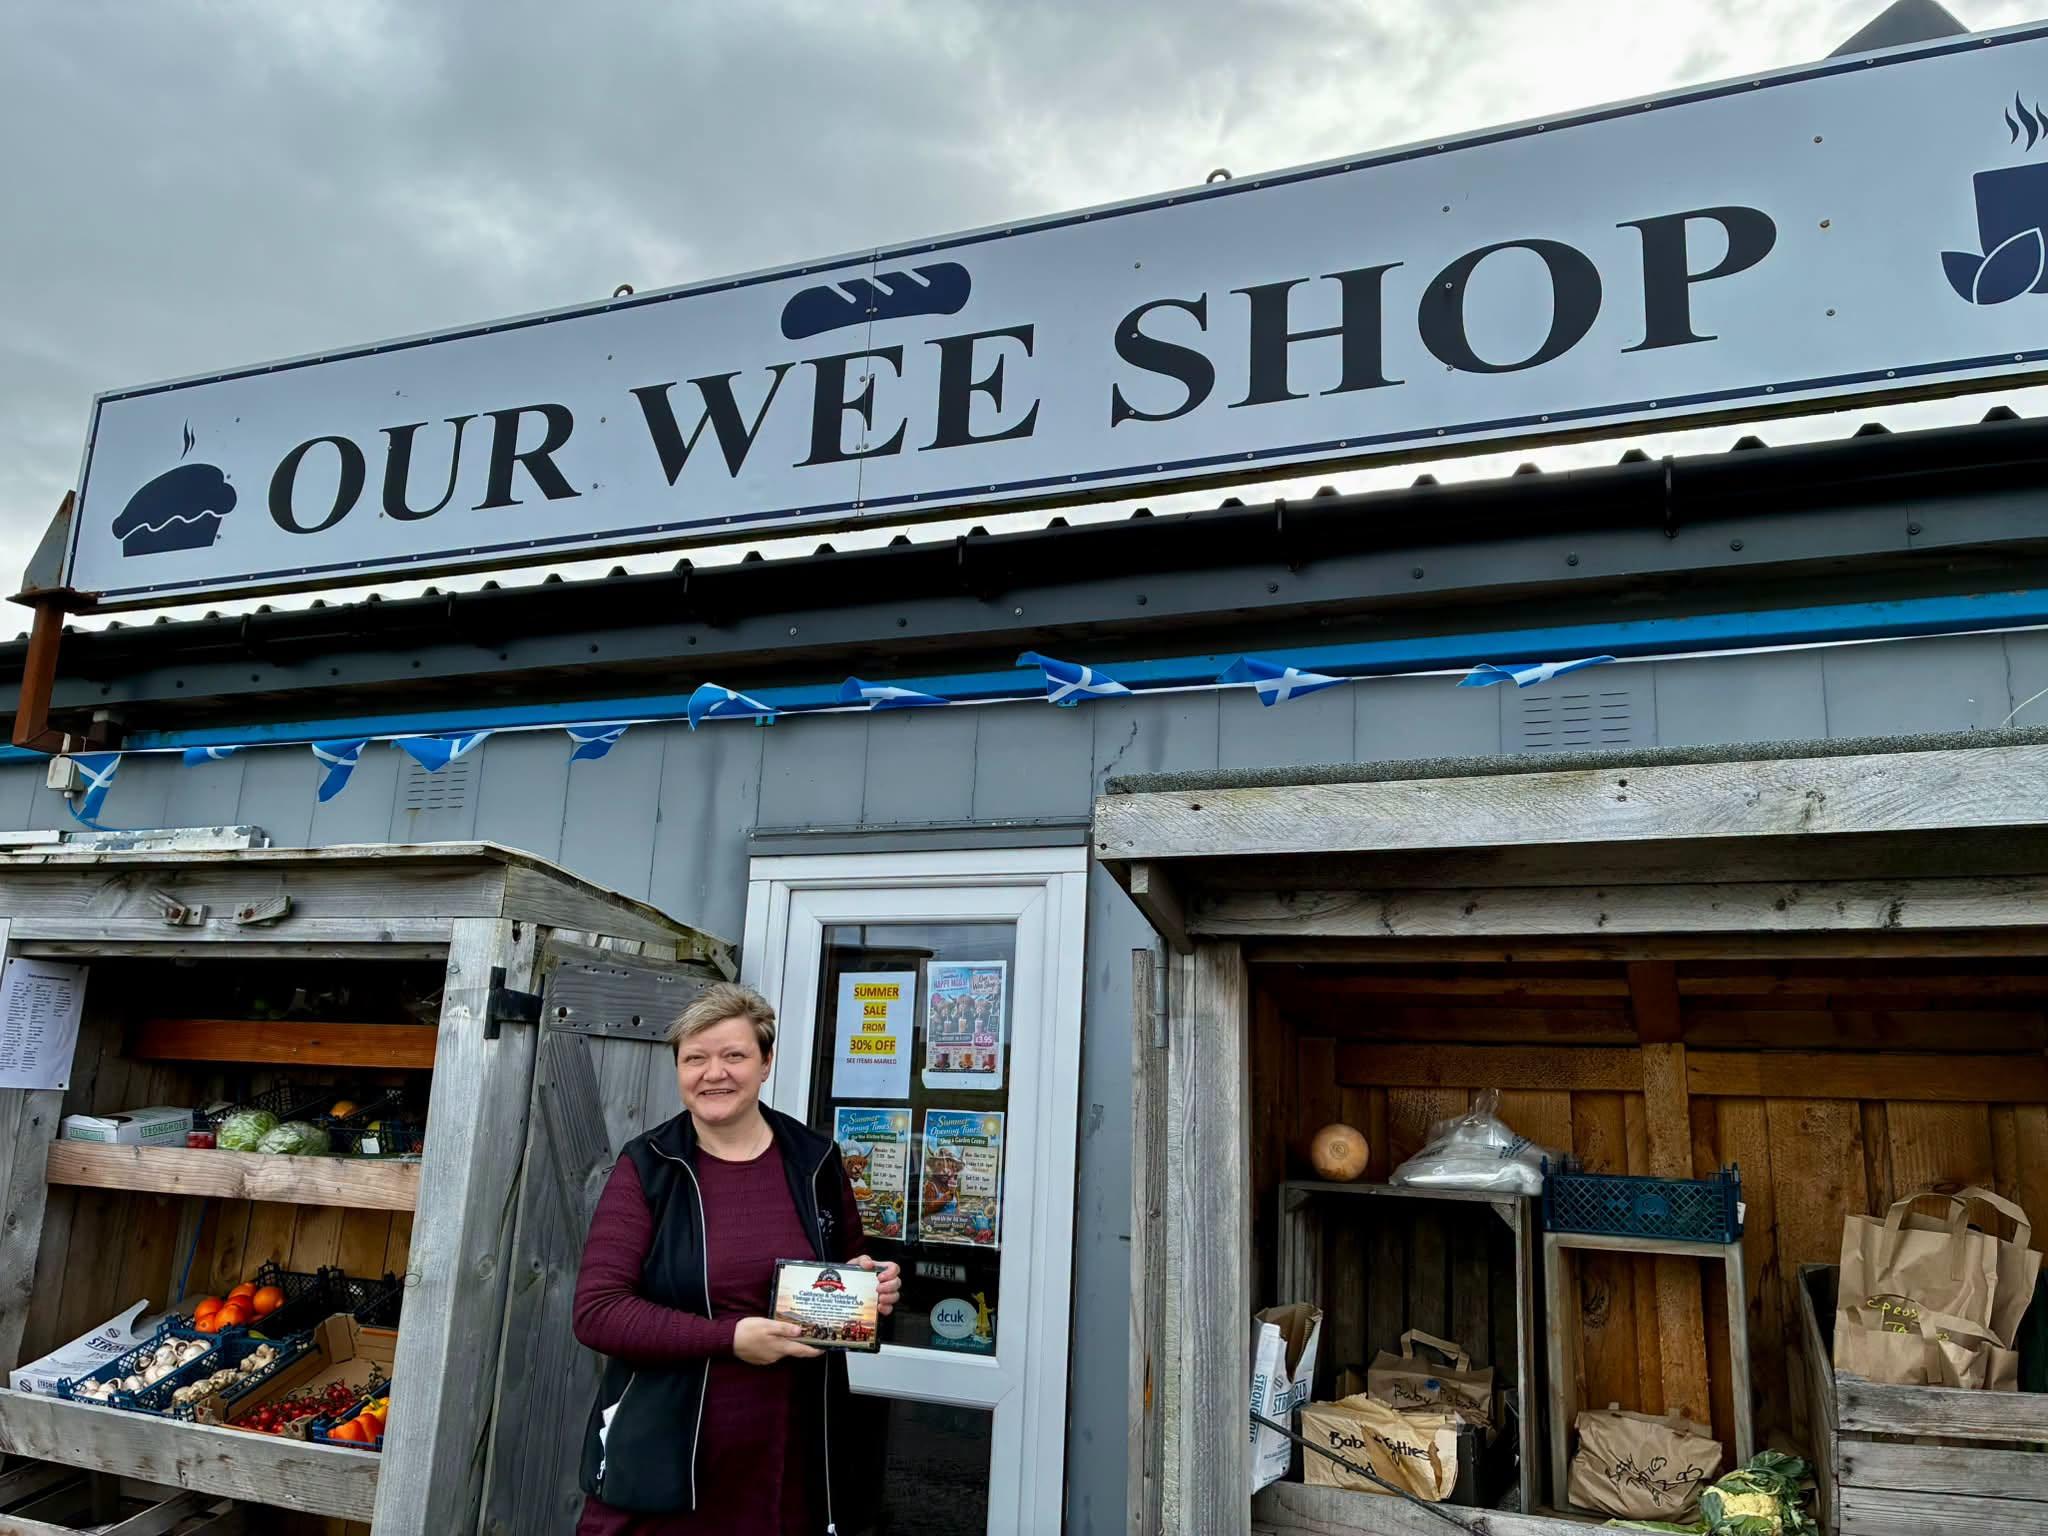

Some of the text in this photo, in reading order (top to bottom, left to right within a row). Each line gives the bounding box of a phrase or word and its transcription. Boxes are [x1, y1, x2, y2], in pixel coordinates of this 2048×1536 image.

[268, 206, 1777, 535] OUR WEE SHOP
[854, 986, 899, 997] SUMMER
[864, 1005, 886, 1016] SALE
[862, 1023, 886, 1032] FROM
[850, 1039, 896, 1051] 30% OFF
[849, 1113, 881, 1124] Summer
[938, 1114, 969, 1127] Summer
[141, 1119, 188, 1138] STRONGHOLD
[842, 1120, 894, 1134] Opening Times!
[931, 1124, 984, 1138] Opening Times!
[937, 1308, 964, 1323] dcuk
[1394, 1383, 1431, 1405] Baby
